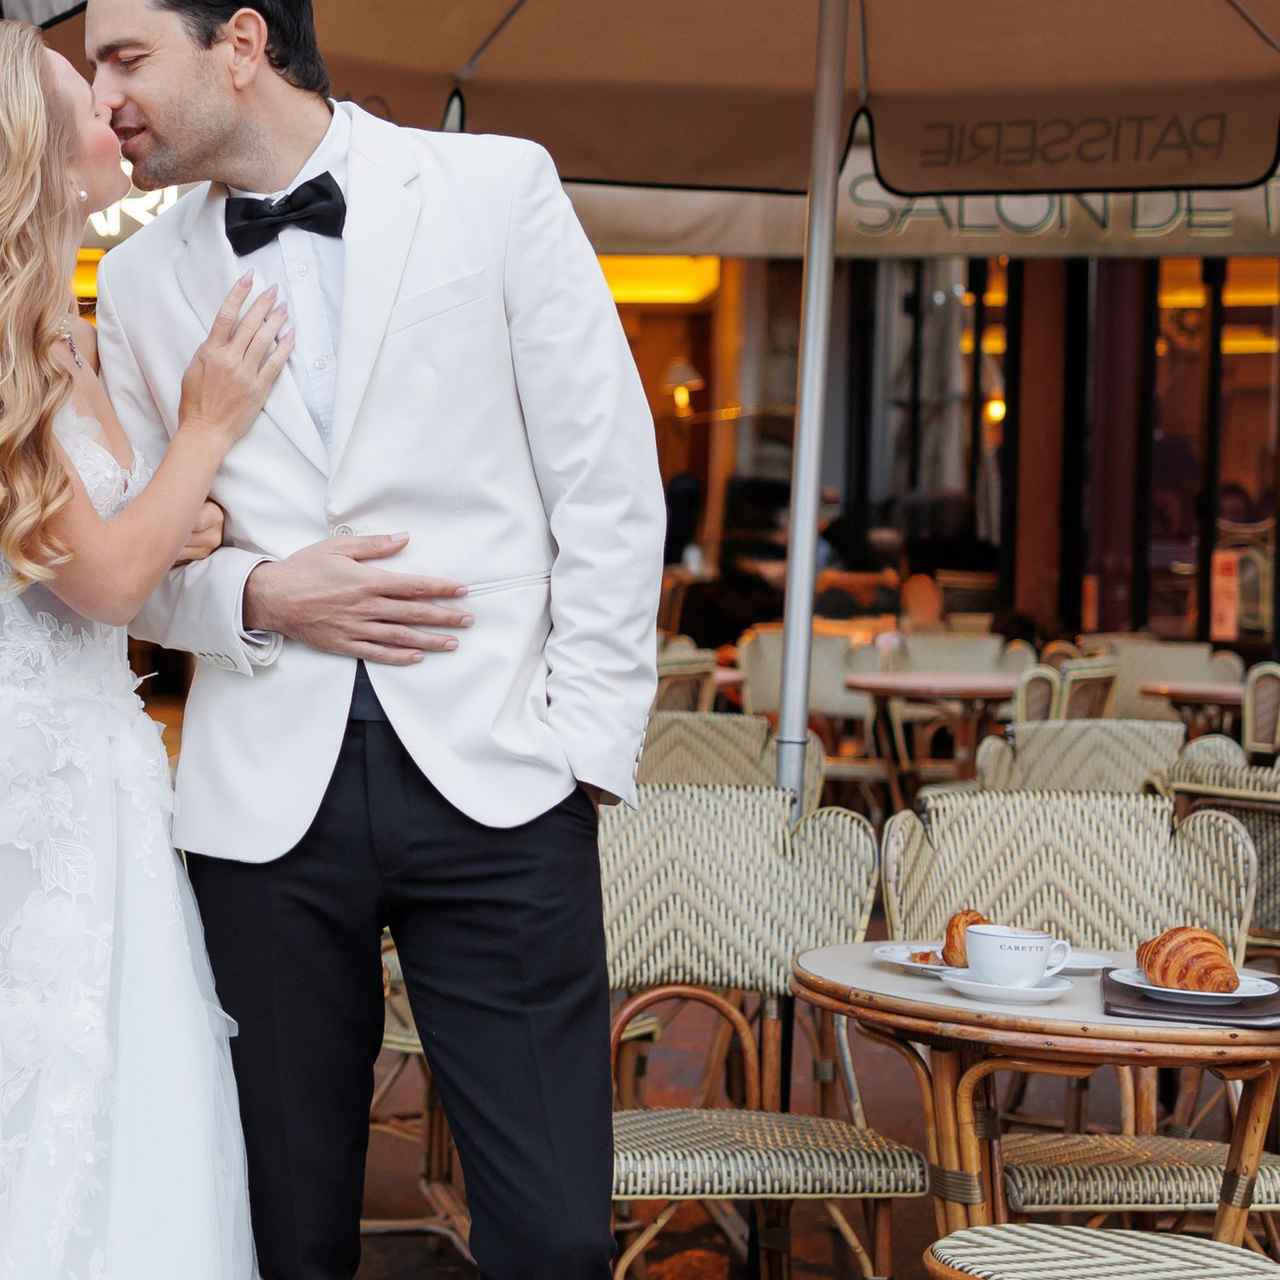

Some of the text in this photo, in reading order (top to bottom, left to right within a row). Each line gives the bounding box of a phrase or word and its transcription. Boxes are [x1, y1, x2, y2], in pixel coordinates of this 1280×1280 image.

[849, 173, 1113, 237] SALON
[1131, 192, 1235, 238] DE
[999, 944, 1045, 952] CARETTE
